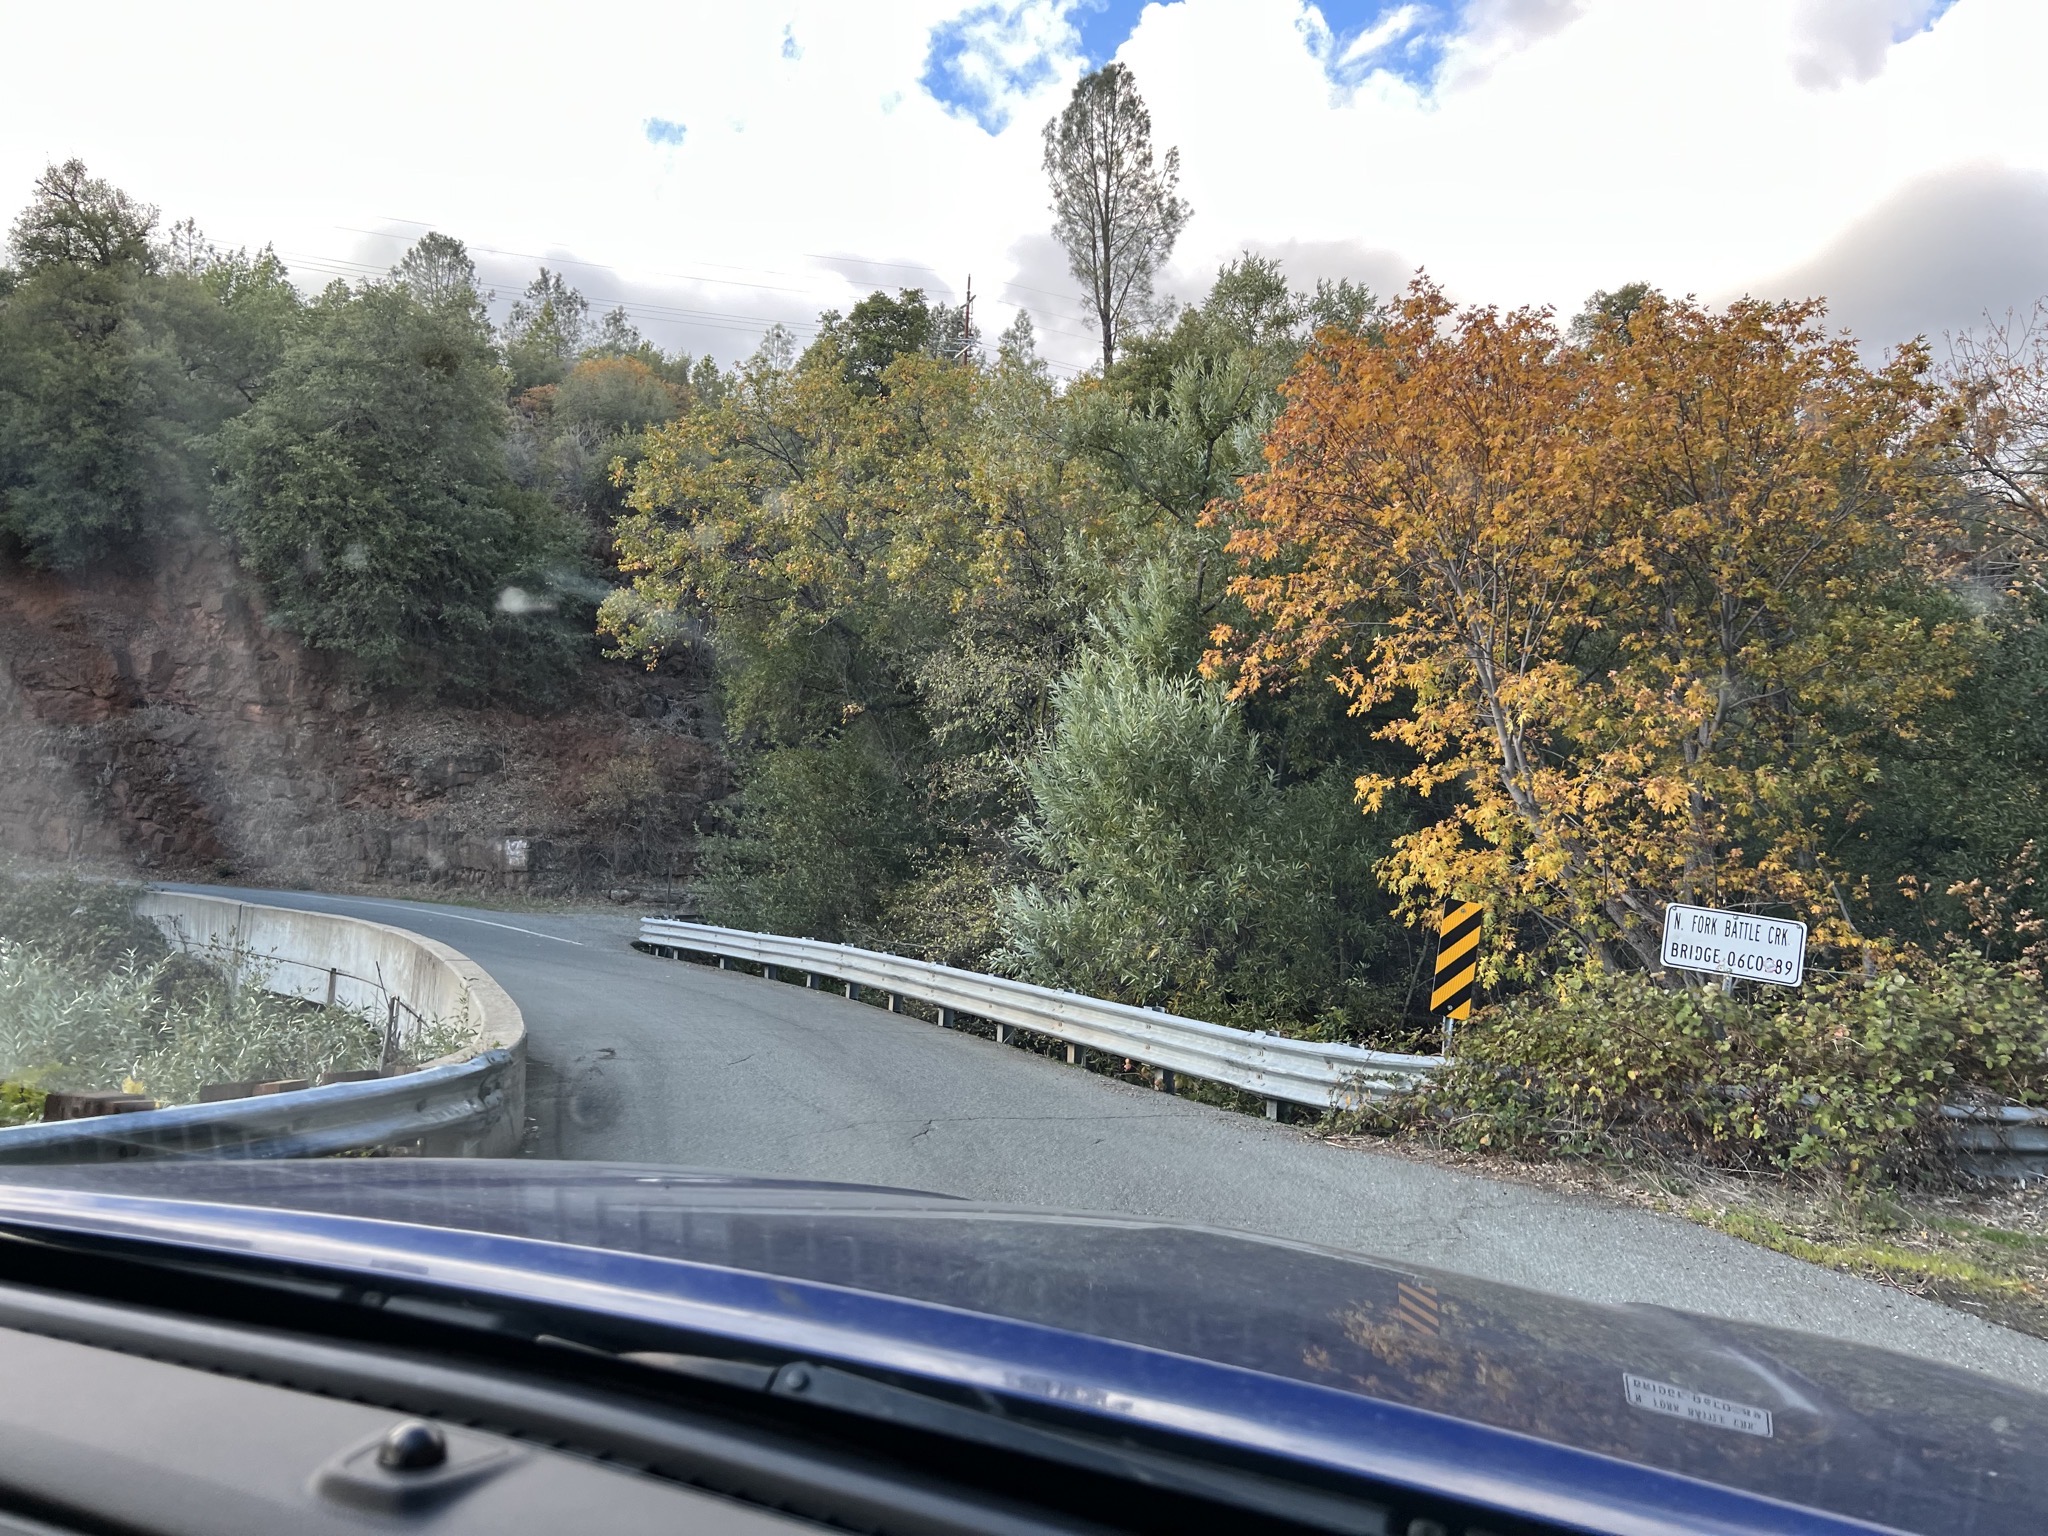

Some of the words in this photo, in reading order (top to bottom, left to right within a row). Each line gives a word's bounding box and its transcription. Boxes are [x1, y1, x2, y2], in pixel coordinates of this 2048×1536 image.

[1674, 912, 1684, 931] N.
[1692, 915, 1718, 935] FORK
[1724, 919, 1761, 942] BATTLE
[1671, 942, 1720, 964] BRIDGE
